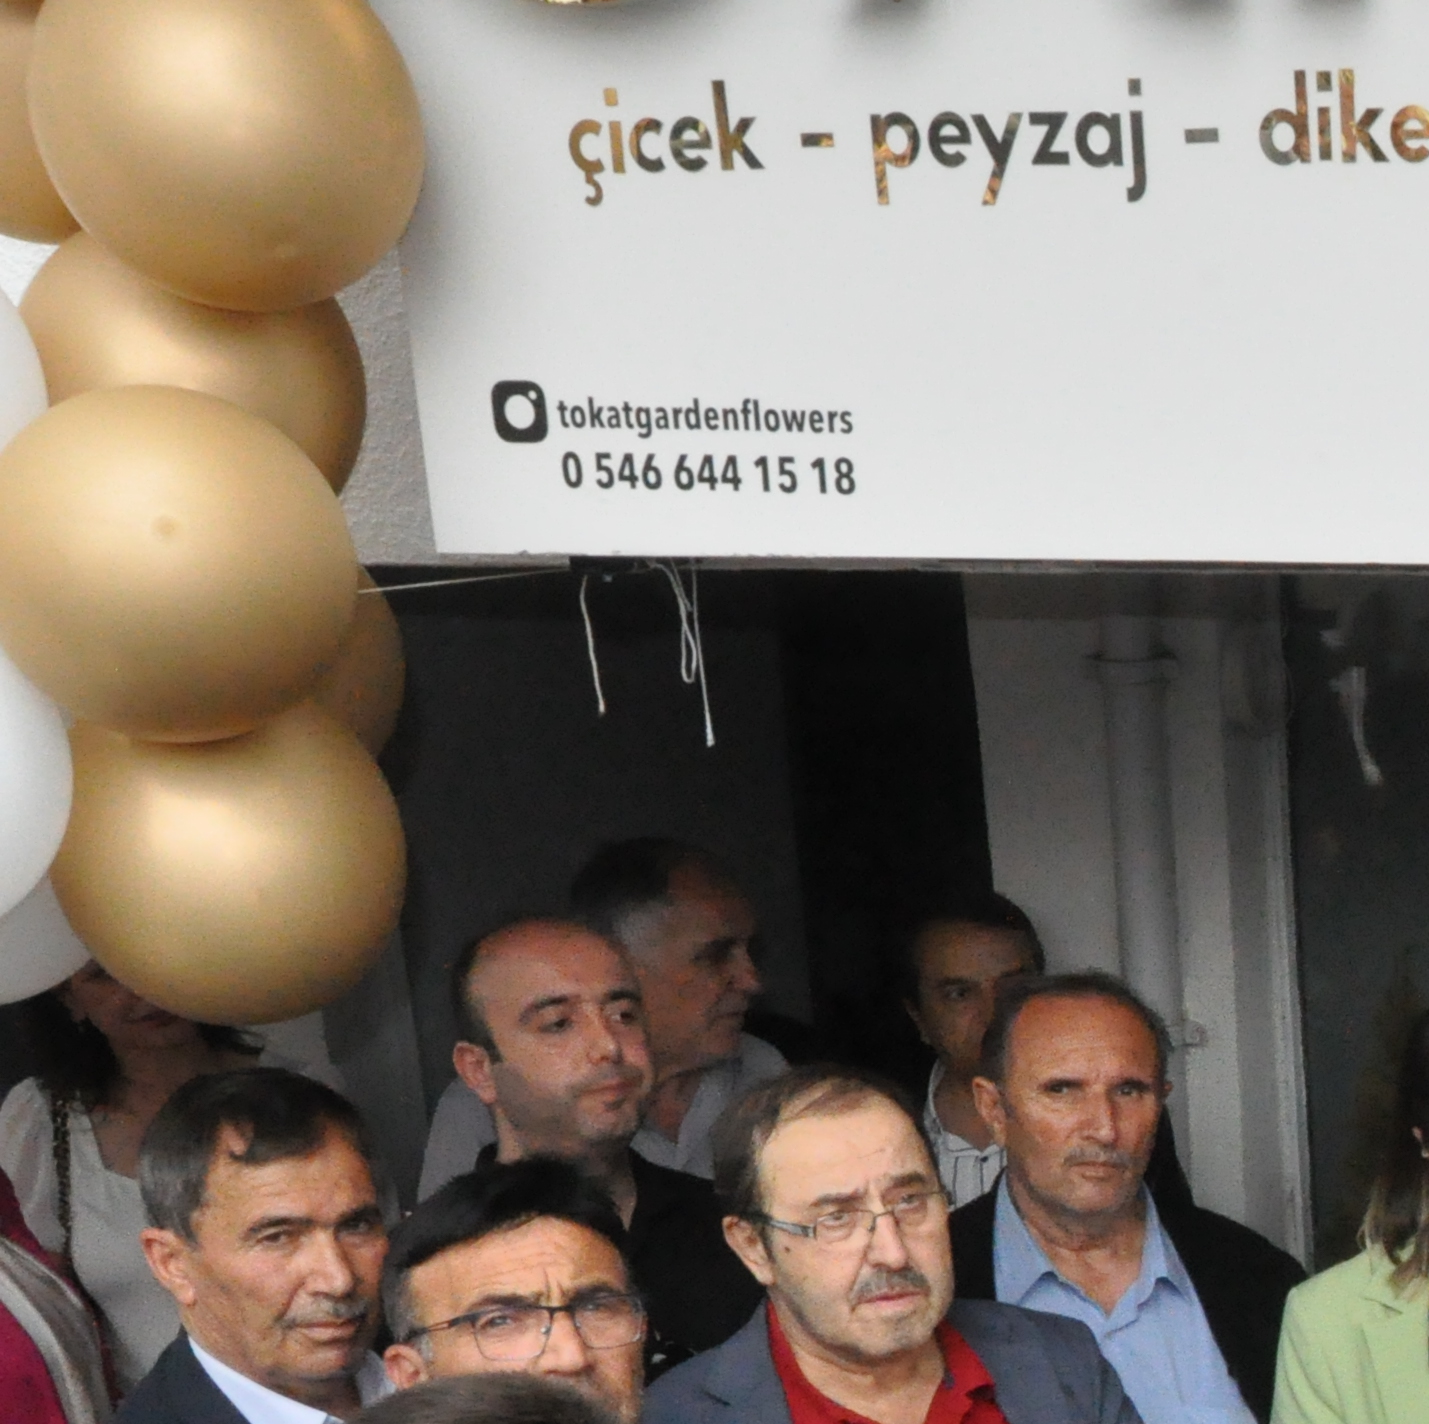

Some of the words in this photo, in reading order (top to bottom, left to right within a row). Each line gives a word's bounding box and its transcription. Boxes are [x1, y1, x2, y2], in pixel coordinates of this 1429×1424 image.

[567, 79, 765, 208] çicek
[869, 77, 1149, 207] peyzaj
[556, 396, 855, 440] tokatgardenflowers
[561, 450, 584, 490] 0
[594, 451, 663, 491] 546
[673, 453, 743, 492] 644
[753, 455, 799, 495] 15
[810, 456, 857, 496] 18
